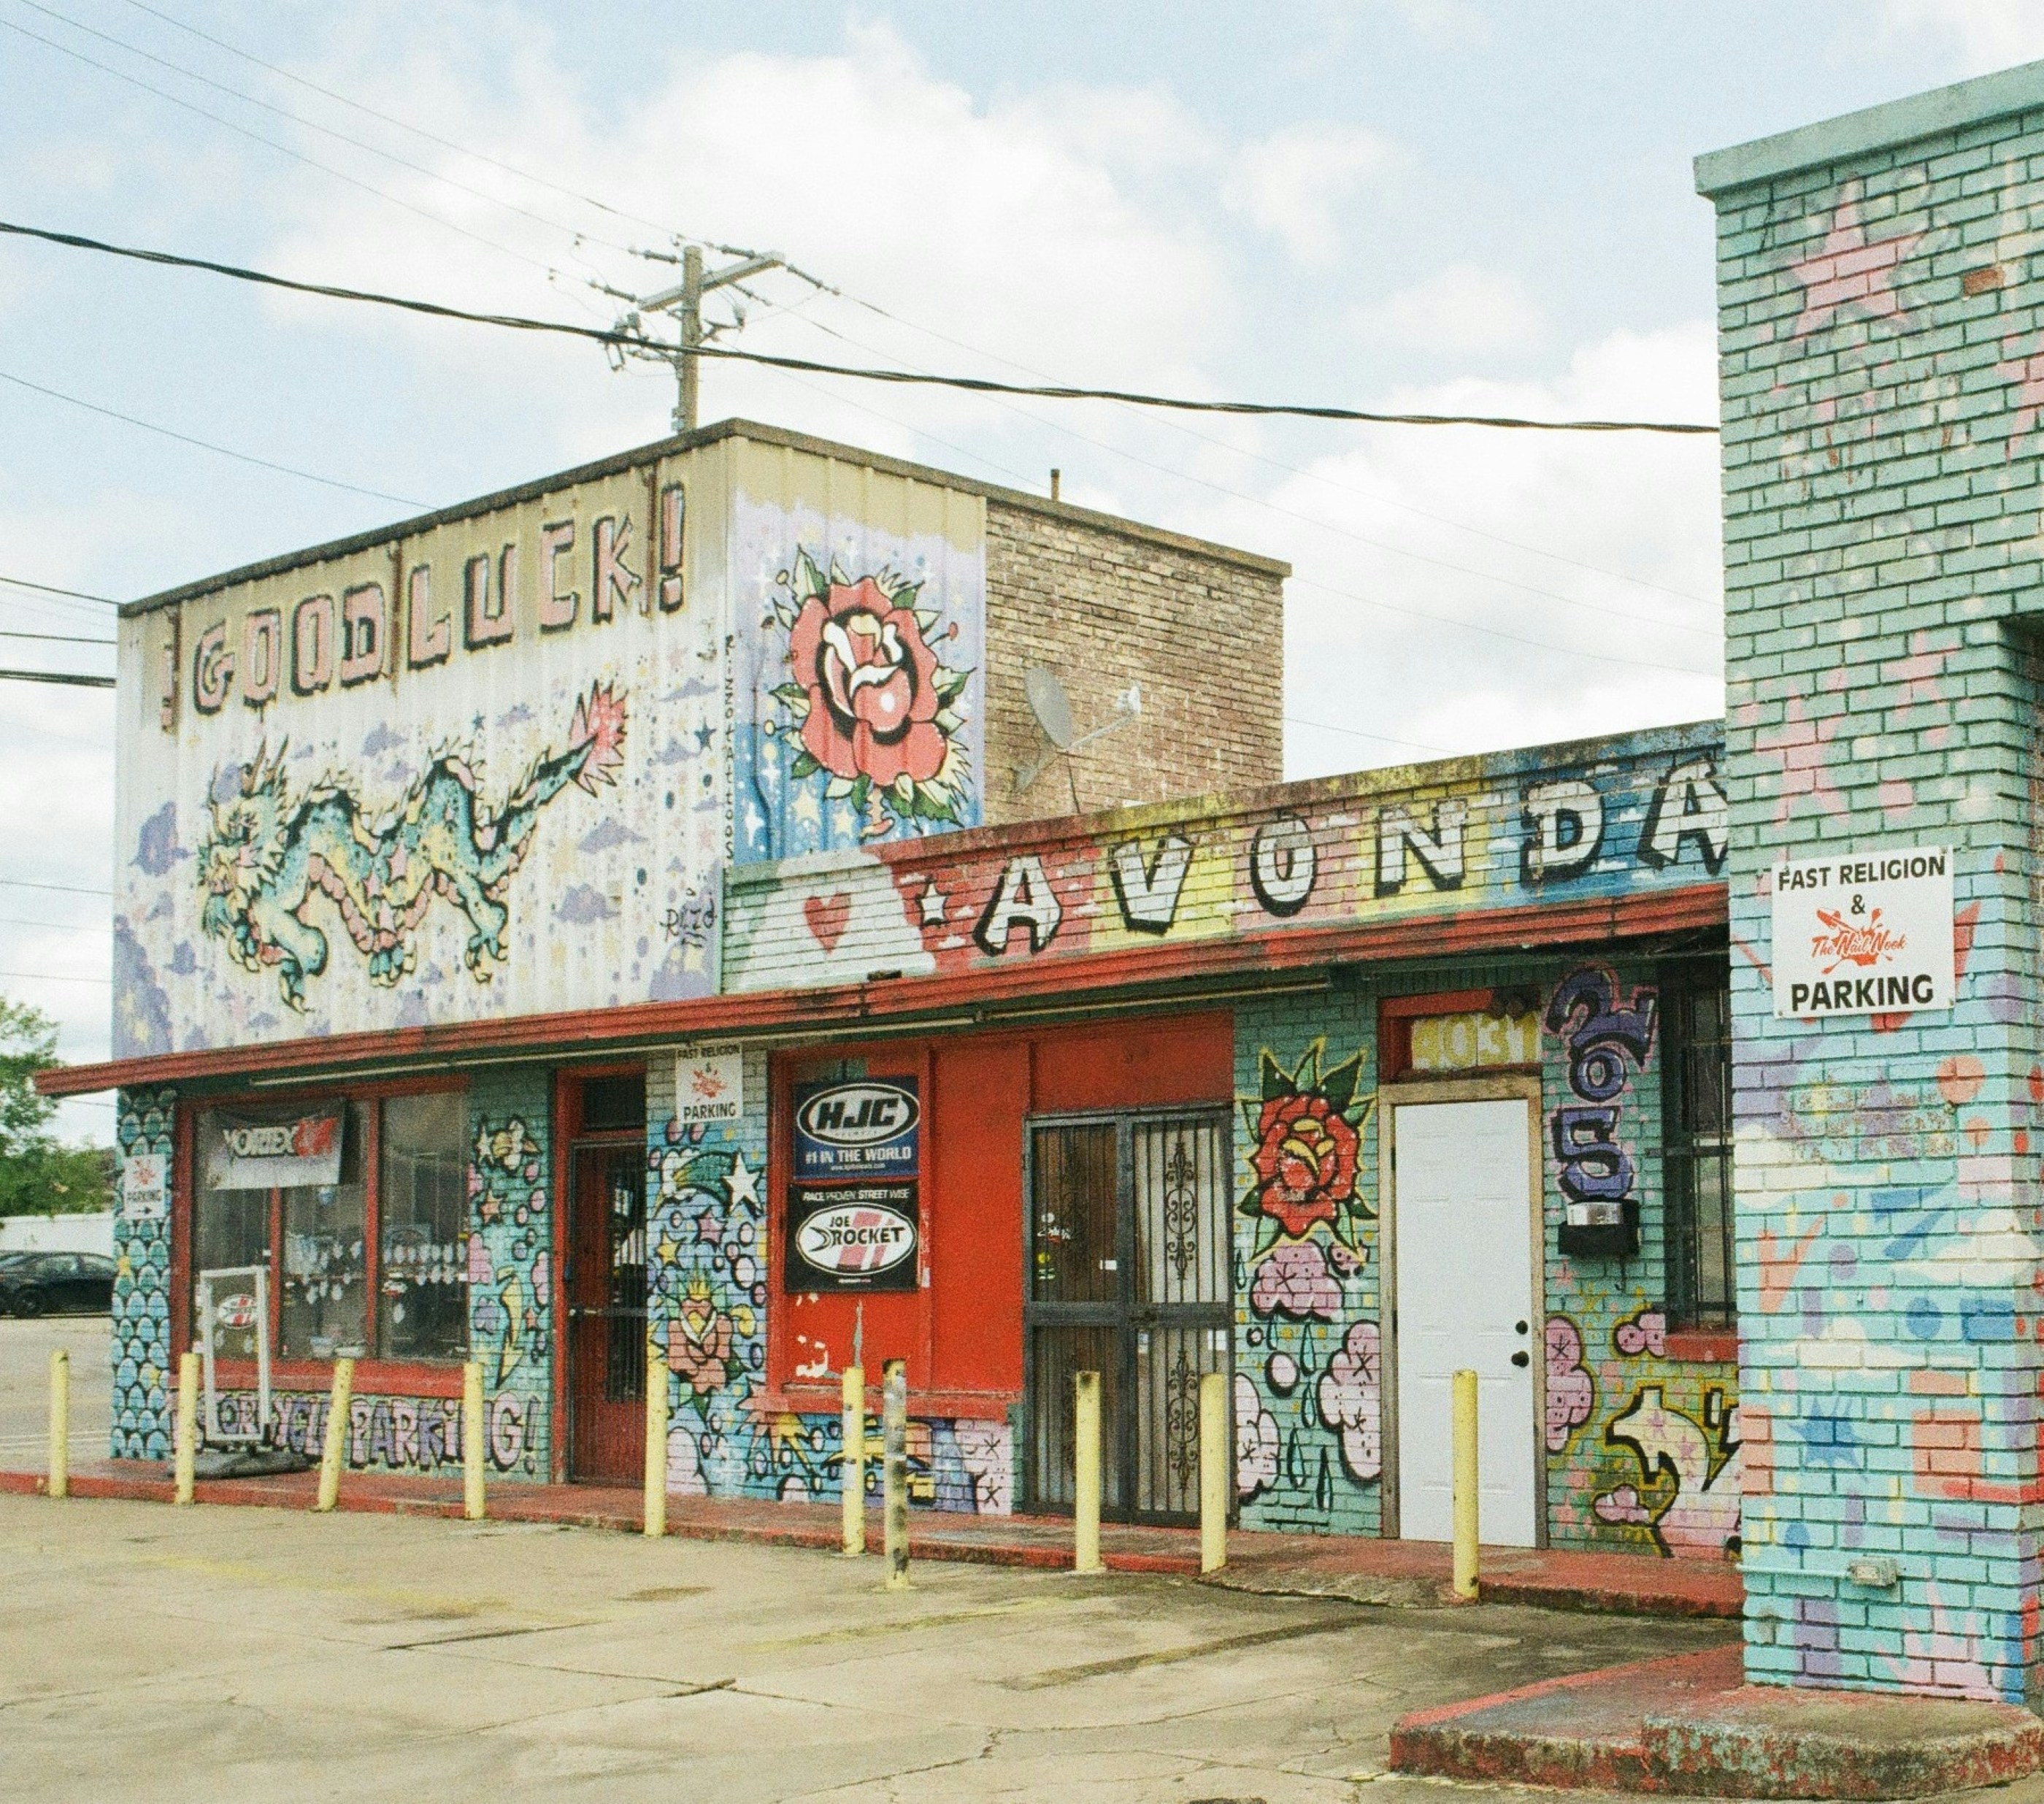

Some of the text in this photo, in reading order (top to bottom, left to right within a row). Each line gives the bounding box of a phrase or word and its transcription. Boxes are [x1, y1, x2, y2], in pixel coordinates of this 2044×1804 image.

[1778, 855, 1945, 891] FAST RELIGION
[1851, 894, 1866, 915] &
[1791, 973, 1934, 1012] PARKING
[683, 1102, 736, 1120] PARKING
[815, 1097, 899, 1130] HJC
[820, 1151, 834, 1164] IN
[836, 1148, 861, 1162] THE
[864, 1146, 912, 1162] WORLD
[858, 1189, 888, 1200] STREET
[829, 1216, 850, 1228] JOE
[831, 1227, 906, 1246] ROCKET
